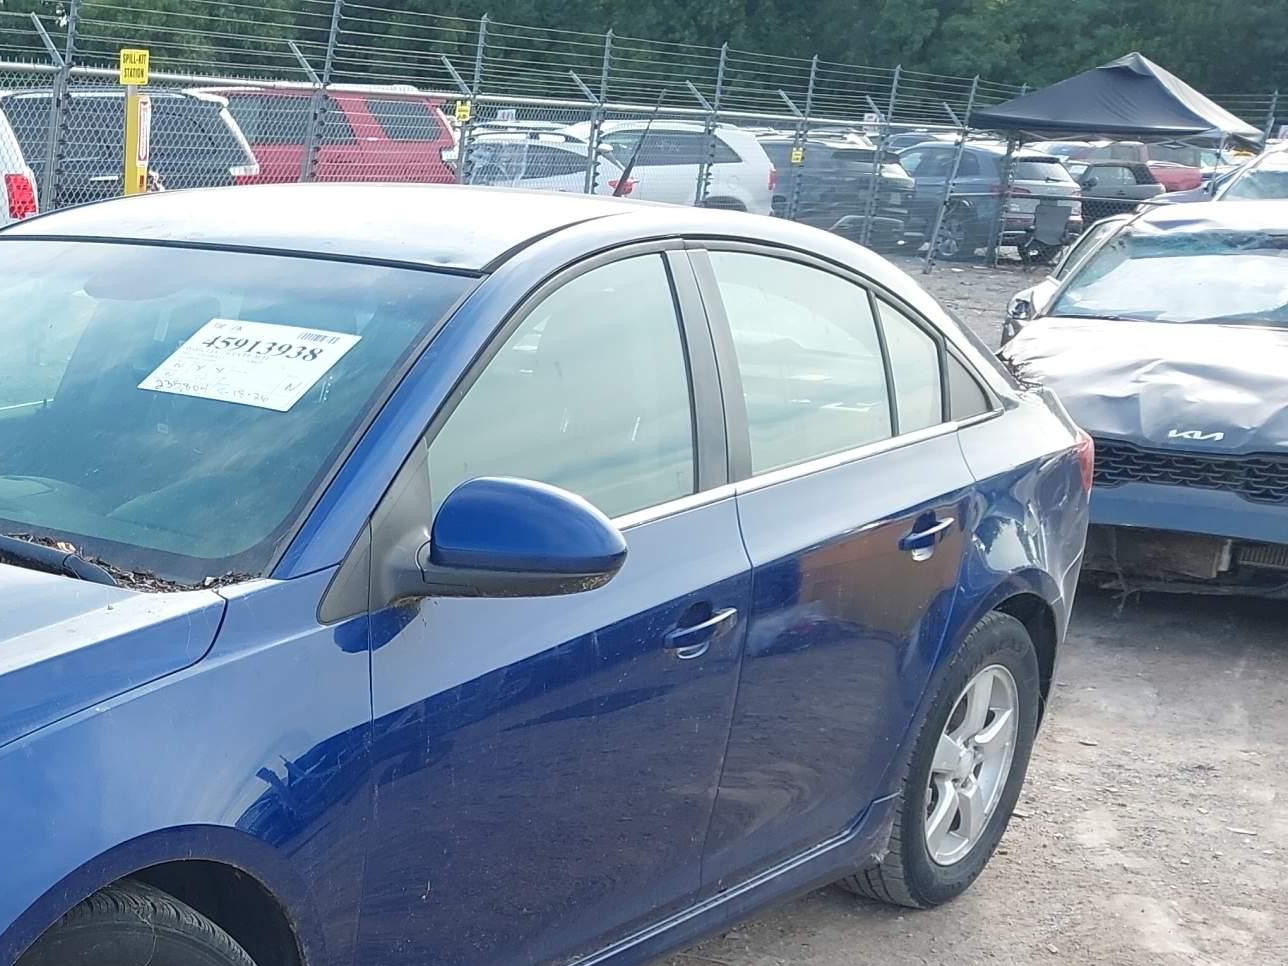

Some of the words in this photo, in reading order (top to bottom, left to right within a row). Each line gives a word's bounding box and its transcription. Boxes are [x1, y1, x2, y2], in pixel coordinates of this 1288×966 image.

[122, 53, 147, 65] SPILL-KIT
[123, 67, 145, 79] STATION
[202, 335, 324, 362] 45913938
